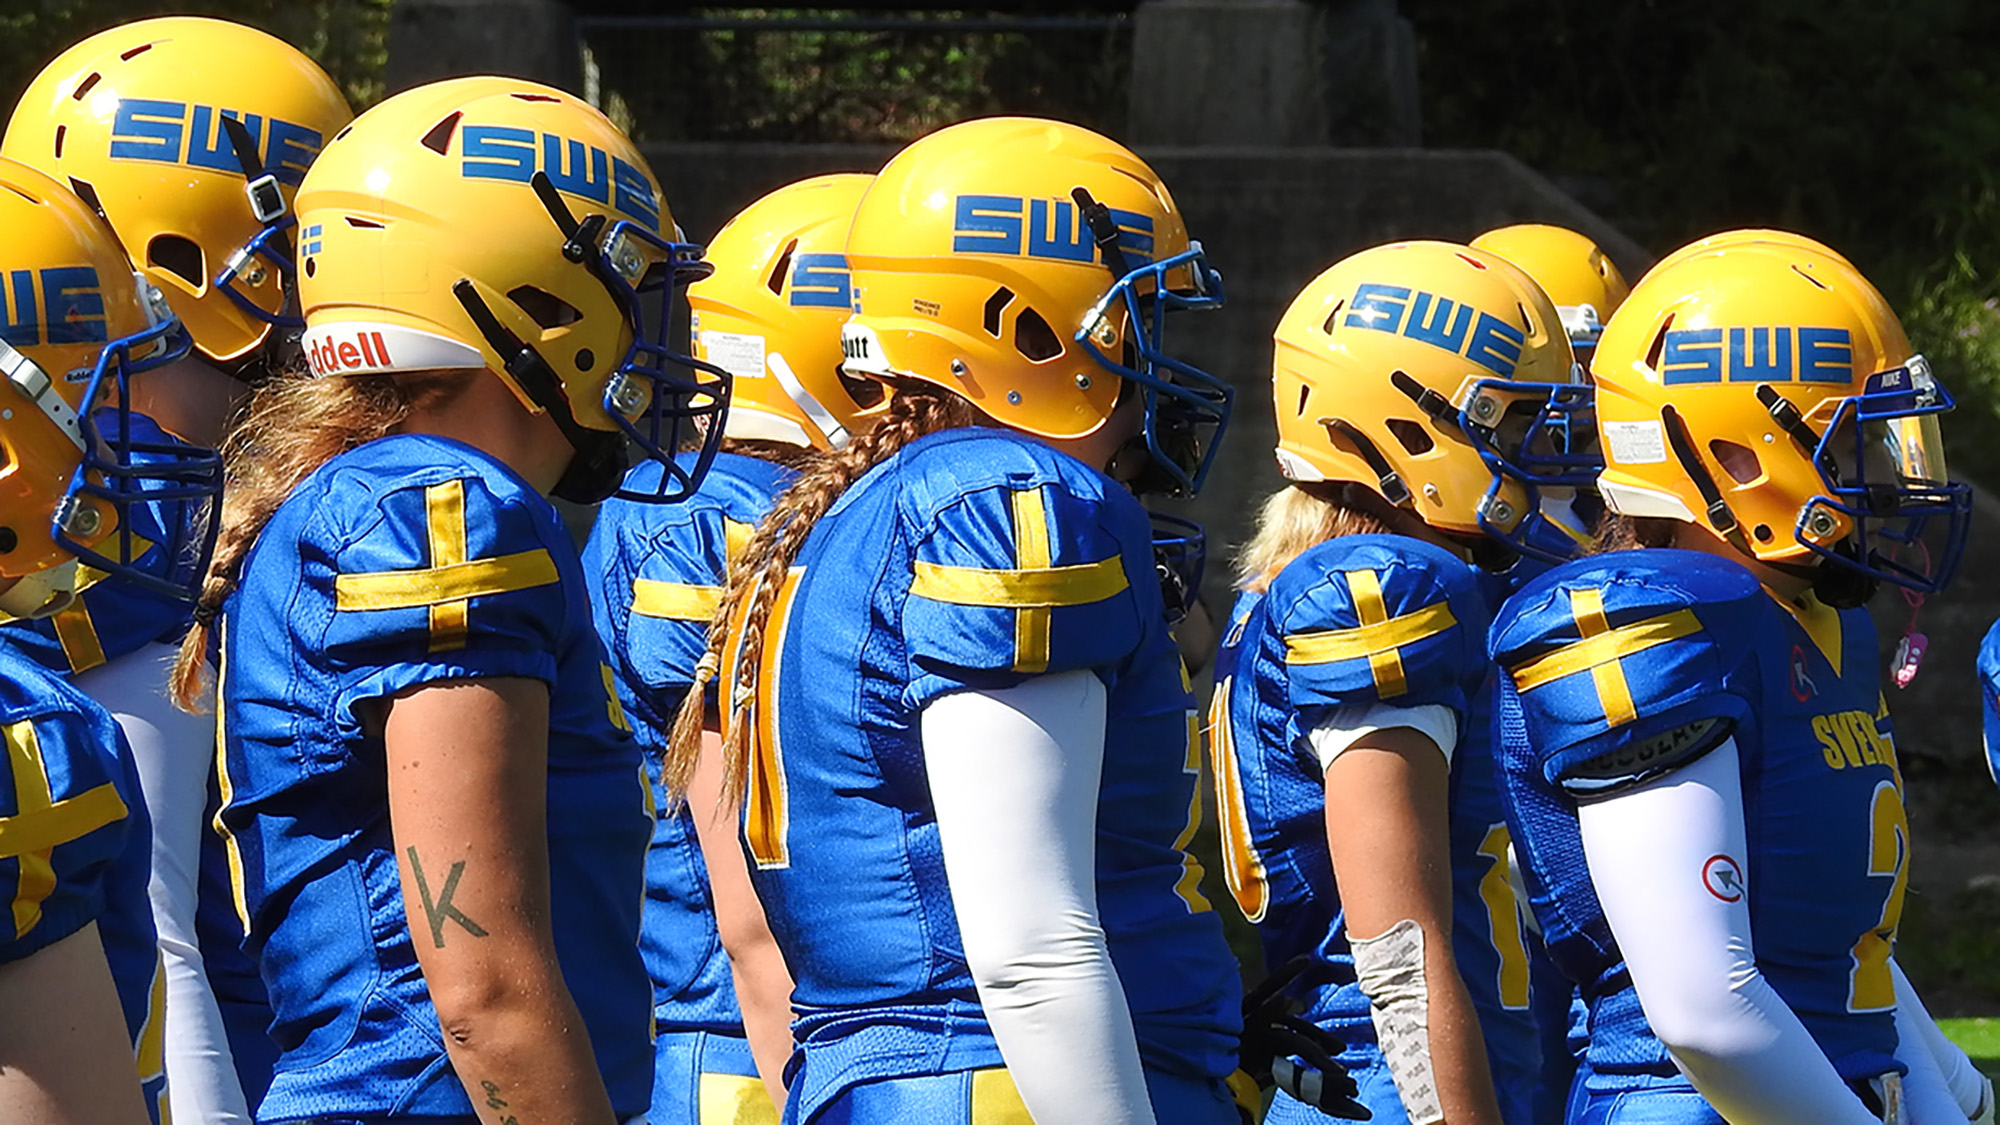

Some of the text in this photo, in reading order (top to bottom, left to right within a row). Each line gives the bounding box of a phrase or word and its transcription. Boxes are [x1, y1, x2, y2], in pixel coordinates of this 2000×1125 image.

[110, 98, 323, 187] SWE
[462, 125, 660, 233] SWE
[953, 195, 1154, 269] SWE
[309, 331, 391, 375] ddell
[1344, 283, 1526, 380] SWE
[1663, 327, 1852, 386] SWE
[406, 845, 490, 949] K
